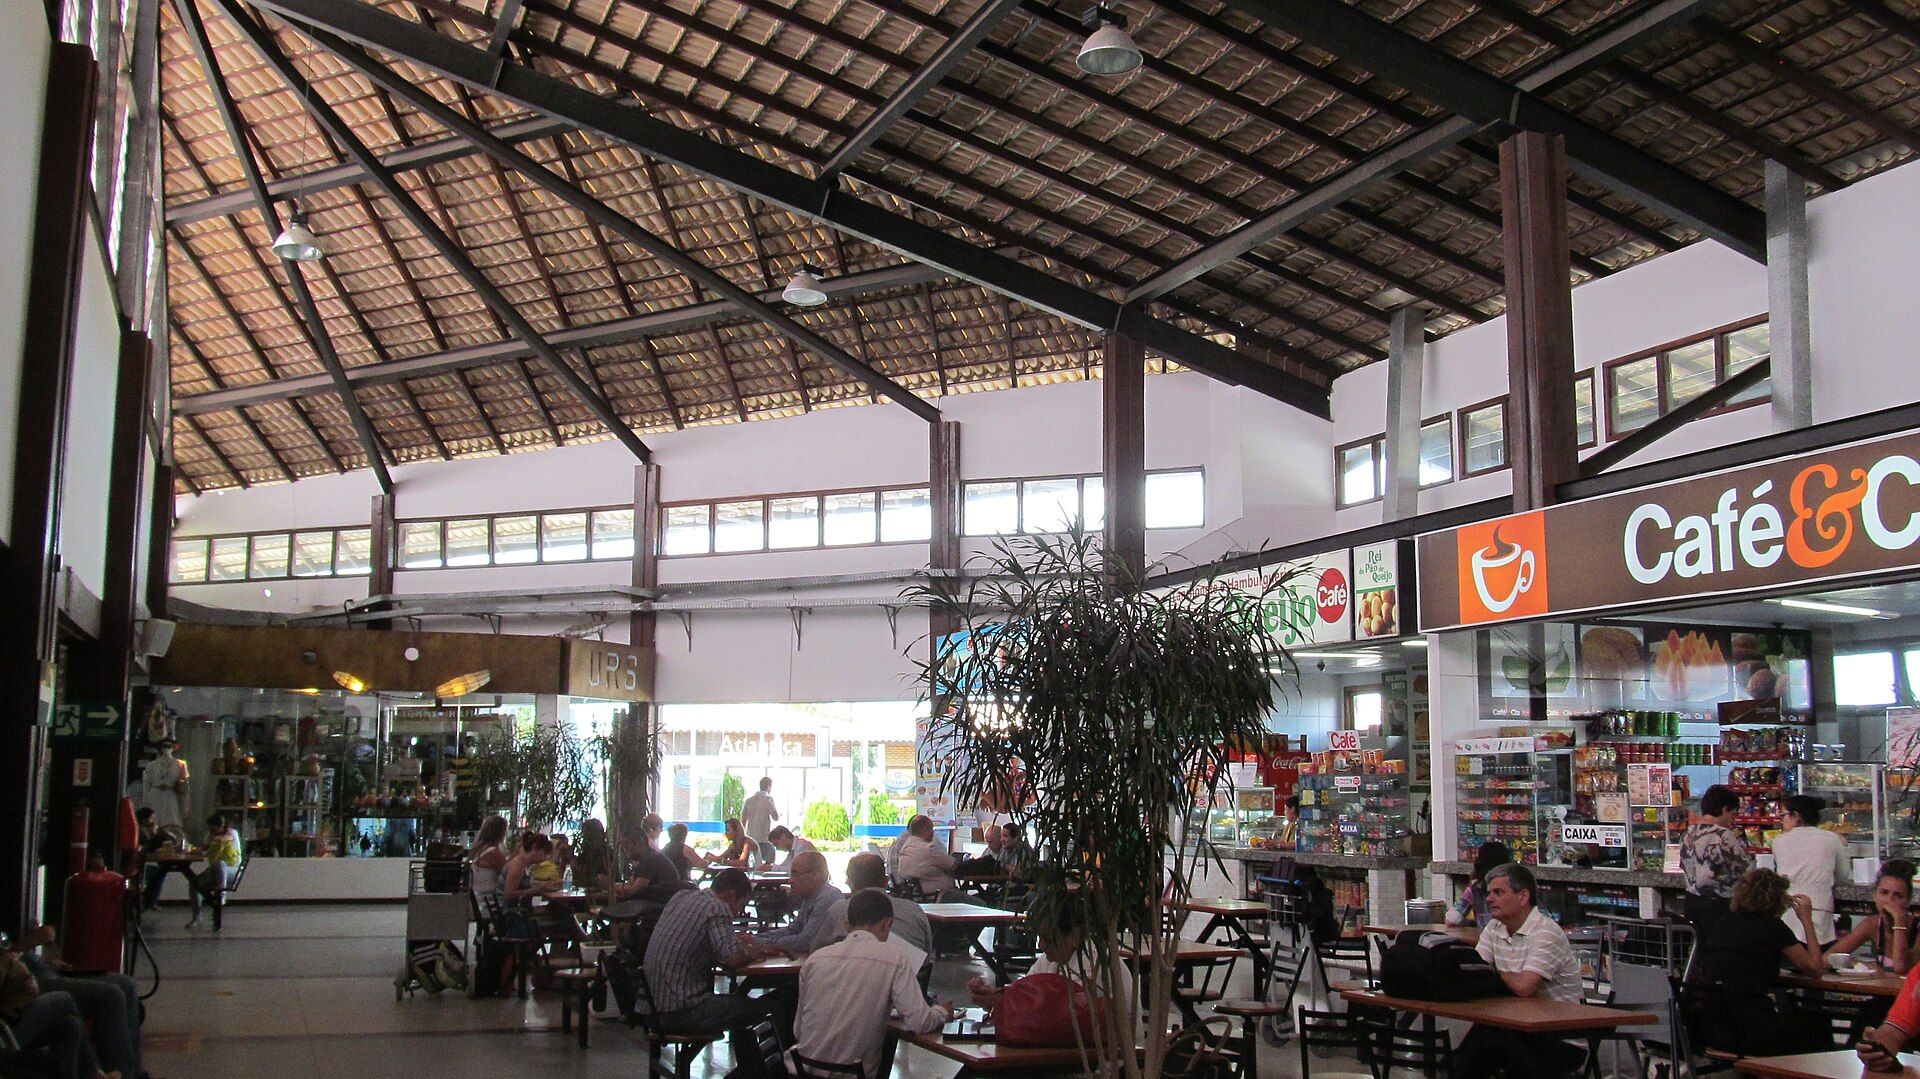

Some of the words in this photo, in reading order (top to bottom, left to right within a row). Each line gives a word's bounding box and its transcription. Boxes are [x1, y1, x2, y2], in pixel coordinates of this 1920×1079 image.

[1624, 479, 1784, 584] Café
[1368, 549, 1382, 564] Rei
[1372, 570, 1393, 583] Queijo
[1317, 584, 1347, 608] Café
[588, 650, 638, 690] URS
[1330, 730, 1356, 749] Café
[1339, 824, 1357, 833] CAIXA
[1564, 827, 1597, 839] CAIXA
